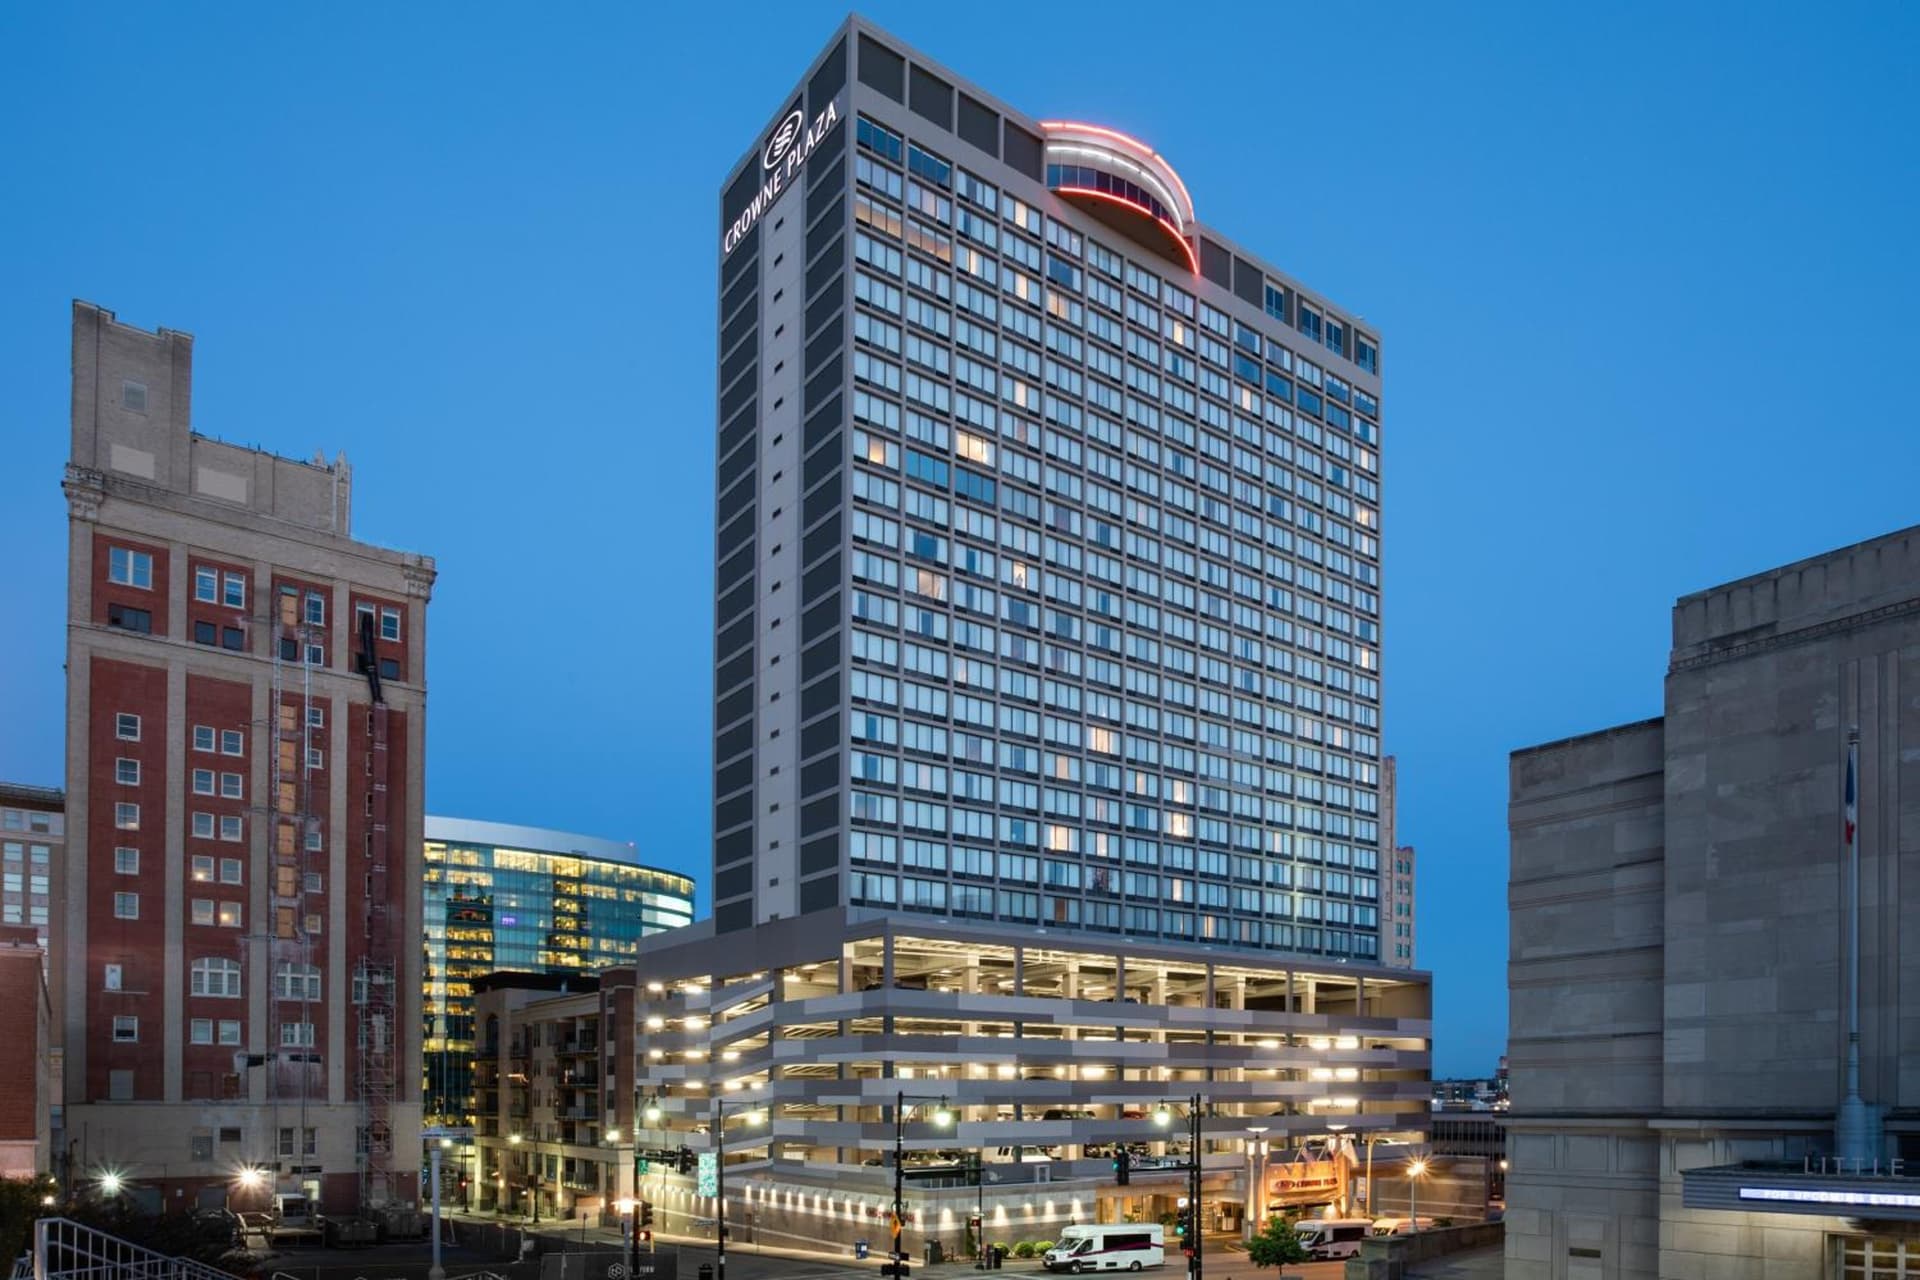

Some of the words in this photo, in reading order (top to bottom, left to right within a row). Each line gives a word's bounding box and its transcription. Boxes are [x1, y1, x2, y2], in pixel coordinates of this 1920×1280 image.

[725, 167, 783, 253] CROWNE
[787, 101, 837, 177] PLAZA
[1804, 1156, 1905, 1178] LITTLE
